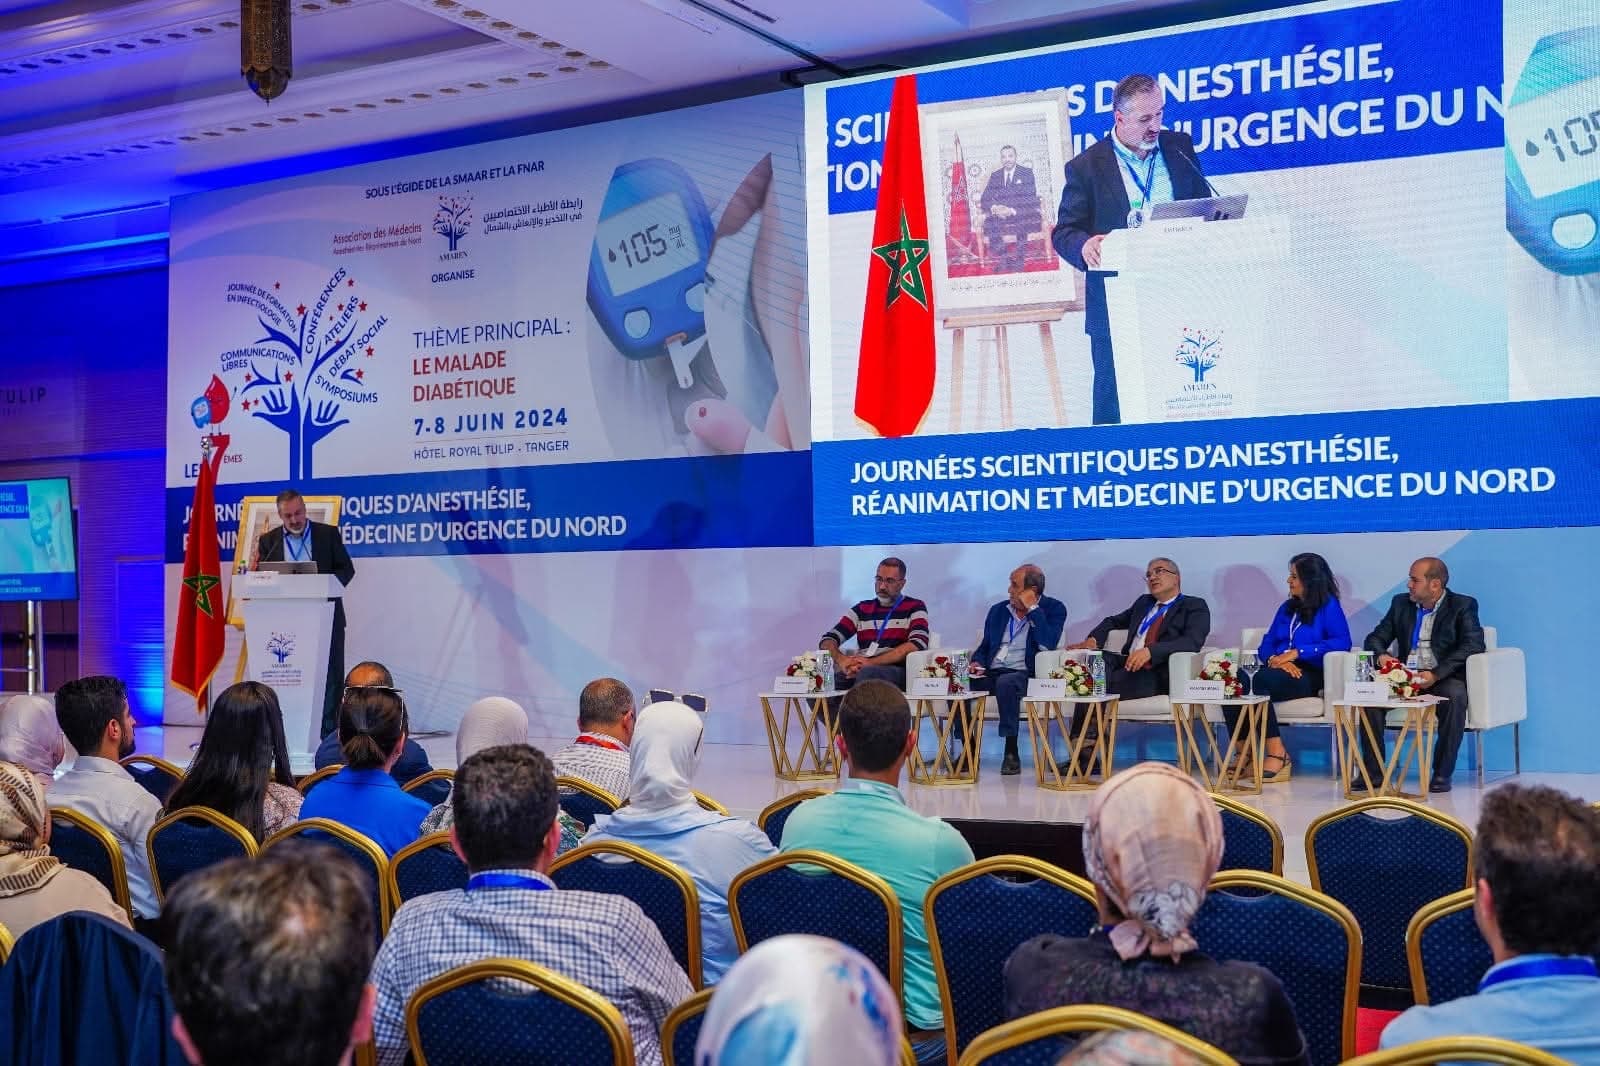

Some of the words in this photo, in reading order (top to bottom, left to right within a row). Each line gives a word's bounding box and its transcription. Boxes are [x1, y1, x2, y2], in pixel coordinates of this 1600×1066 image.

[1396, 87, 1464, 131] DU
[366, 185, 389, 199] SOUS
[391, 180, 424, 195] L'ÉGIDE
[425, 178, 438, 190] DE
[439, 176, 451, 187] LA
[452, 170, 488, 185] SMAAR
[489, 167, 501, 179] ET
[503, 166, 516, 177] LA
[517, 160, 545, 174] FNAR
[560, 198, 583, 209] رابطة
[569, 212, 582, 222] في
[333, 230, 372, 244] Association
[373, 226, 386, 239] des
[388, 222, 422, 236] Médecins
[618, 224, 668, 268] 105
[431, 269, 475, 283] ORGANISE
[227, 294, 236, 302] EN
[237, 295, 281, 326] INFECTIOLOGIE
[228, 283, 257, 295] JOURNÉE
[257, 288, 266, 298] DE
[266, 293, 297, 333] FORMATION
[306, 267, 346, 354] CONFÉRENCES
[324, 296, 358, 345] ATELIERS
[329, 344, 356, 378] DÉBAT
[357, 315, 388, 349] SOCIAL
[412, 326, 470, 349] THÈME
[474, 317, 562, 343] PRINCIPAL
[220, 348, 296, 366] COMMUNICATIONS
[222, 359, 248, 372] LIBRES
[413, 358, 431, 376] LE
[434, 350, 507, 374] MALADE
[315, 375, 378, 404] SYMPOSIUMS
[413, 377, 516, 402] DIABÉTIQUE
[454, 412, 504, 433] JUIN
[515, 407, 568, 429] 2024
[414, 446, 446, 459] HÔTEL
[449, 444, 482, 457] ROYAL
[485, 443, 514, 456] TULIP
[525, 440, 569, 452] TANGER
[851, 454, 977, 484] JOURNÉES
[981, 447, 1178, 479] SCIENTIFIQUES
[1185, 433, 1399, 470] D'ANESTHÉSIE,
[185, 463, 200, 478] LE
[341, 495, 394, 518] IQUES
[397, 486, 531, 514] D'ANESTHÉSIE,
[852, 489, 1030, 516] RÉANIMATION
[1037, 486, 1067, 510] ET
[1073, 481, 1216, 509] MÉDECINE
[1222, 473, 1393, 503] D'URGENCE
[1400, 471, 1447, 498] DU
[1455, 467, 1556, 495] NORD
[339, 522, 417, 545] ÉDECINE
[420, 519, 528, 542] D'URGENCE
[531, 518, 560, 539] DU
[565, 516, 627, 537] NORD
